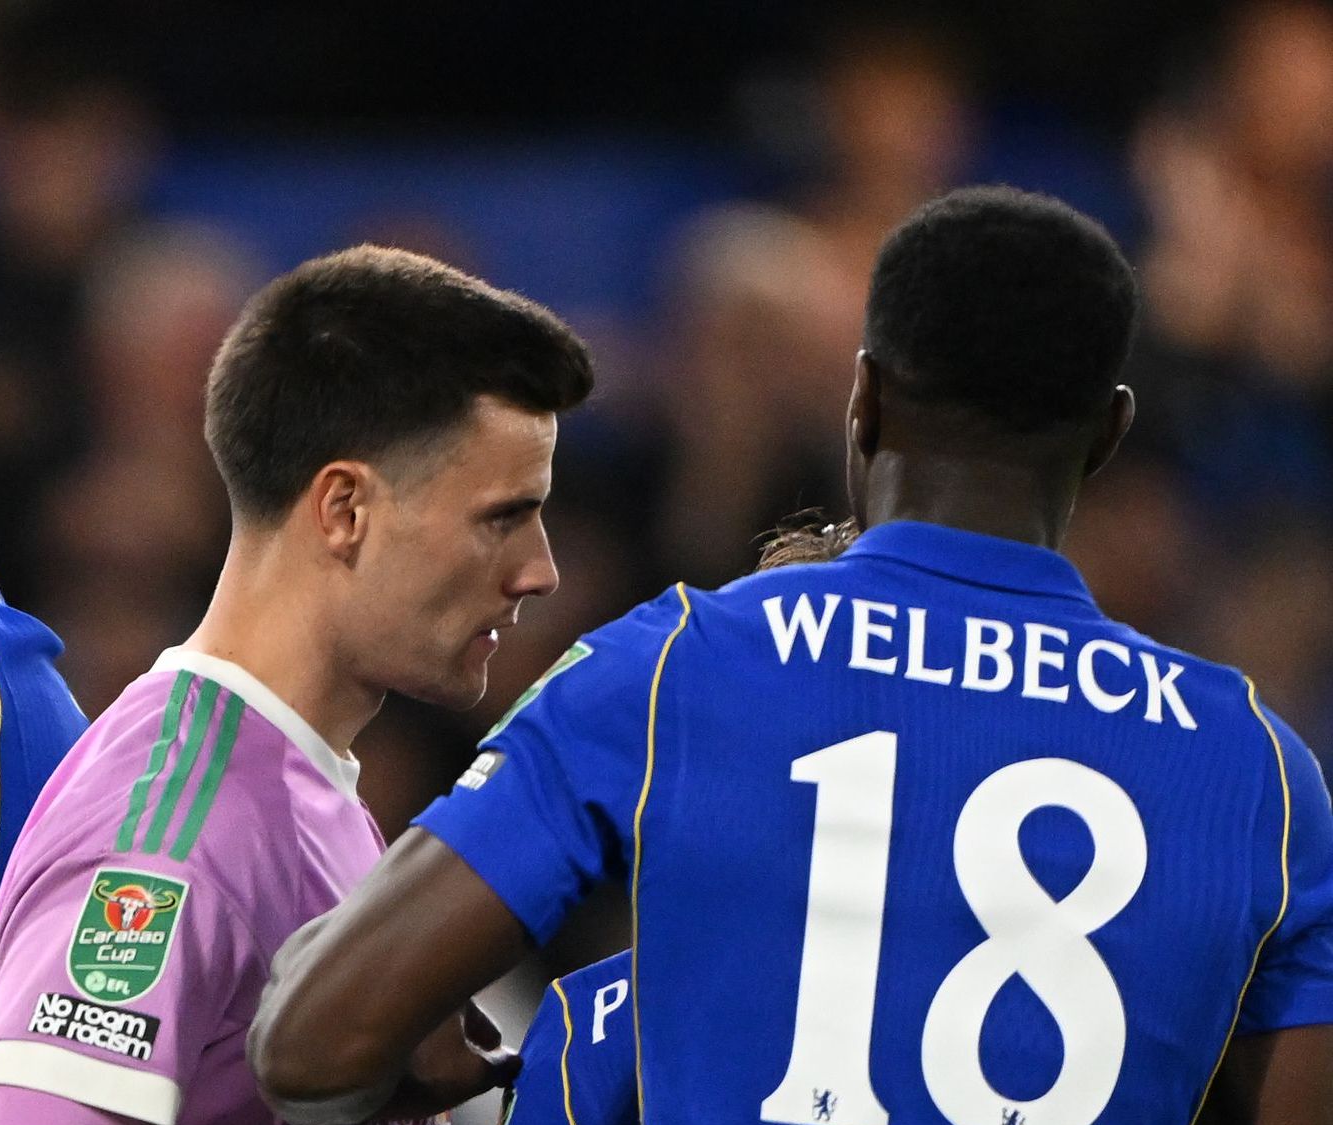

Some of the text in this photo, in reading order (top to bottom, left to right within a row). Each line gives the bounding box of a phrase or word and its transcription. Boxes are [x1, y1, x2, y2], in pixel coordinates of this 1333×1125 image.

[761, 593, 1198, 731] WELBECK
[78, 927, 166, 945] Carabao
[96, 944, 137, 964] Cup
[106, 978, 131, 995] EFL
[33, 992, 147, 1039] No room
[27, 1011, 153, 1061] for racism
